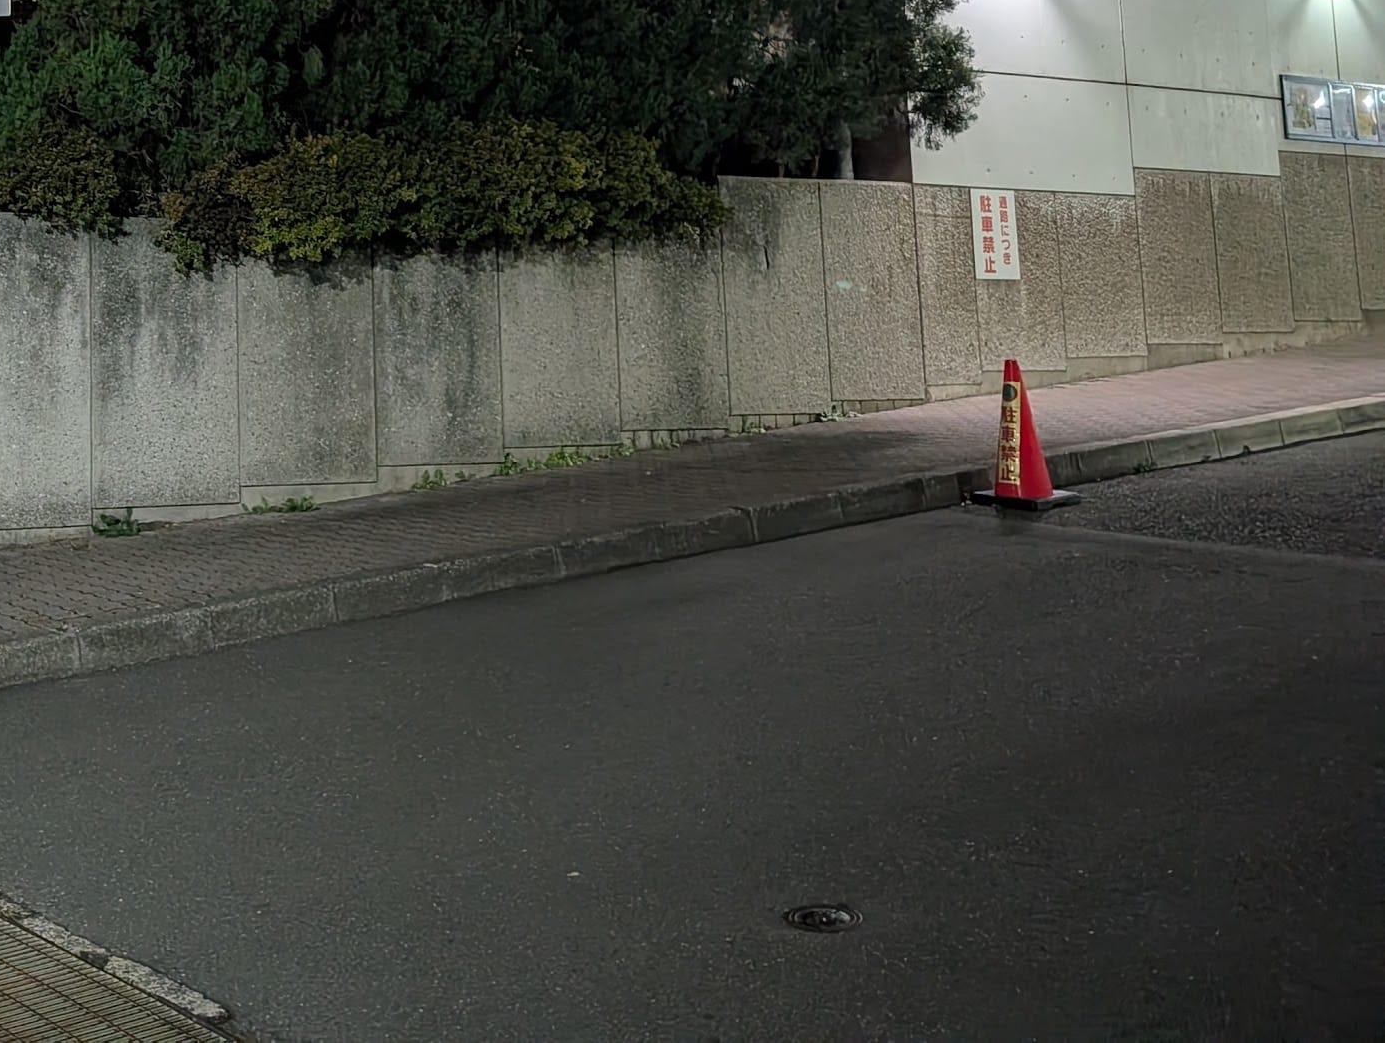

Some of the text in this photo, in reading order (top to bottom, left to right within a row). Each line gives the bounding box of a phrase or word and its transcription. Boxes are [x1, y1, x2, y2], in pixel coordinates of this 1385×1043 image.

[979, 194, 997, 274] 駐車禁止
[1000, 406, 1018, 482] 駐車禁止
